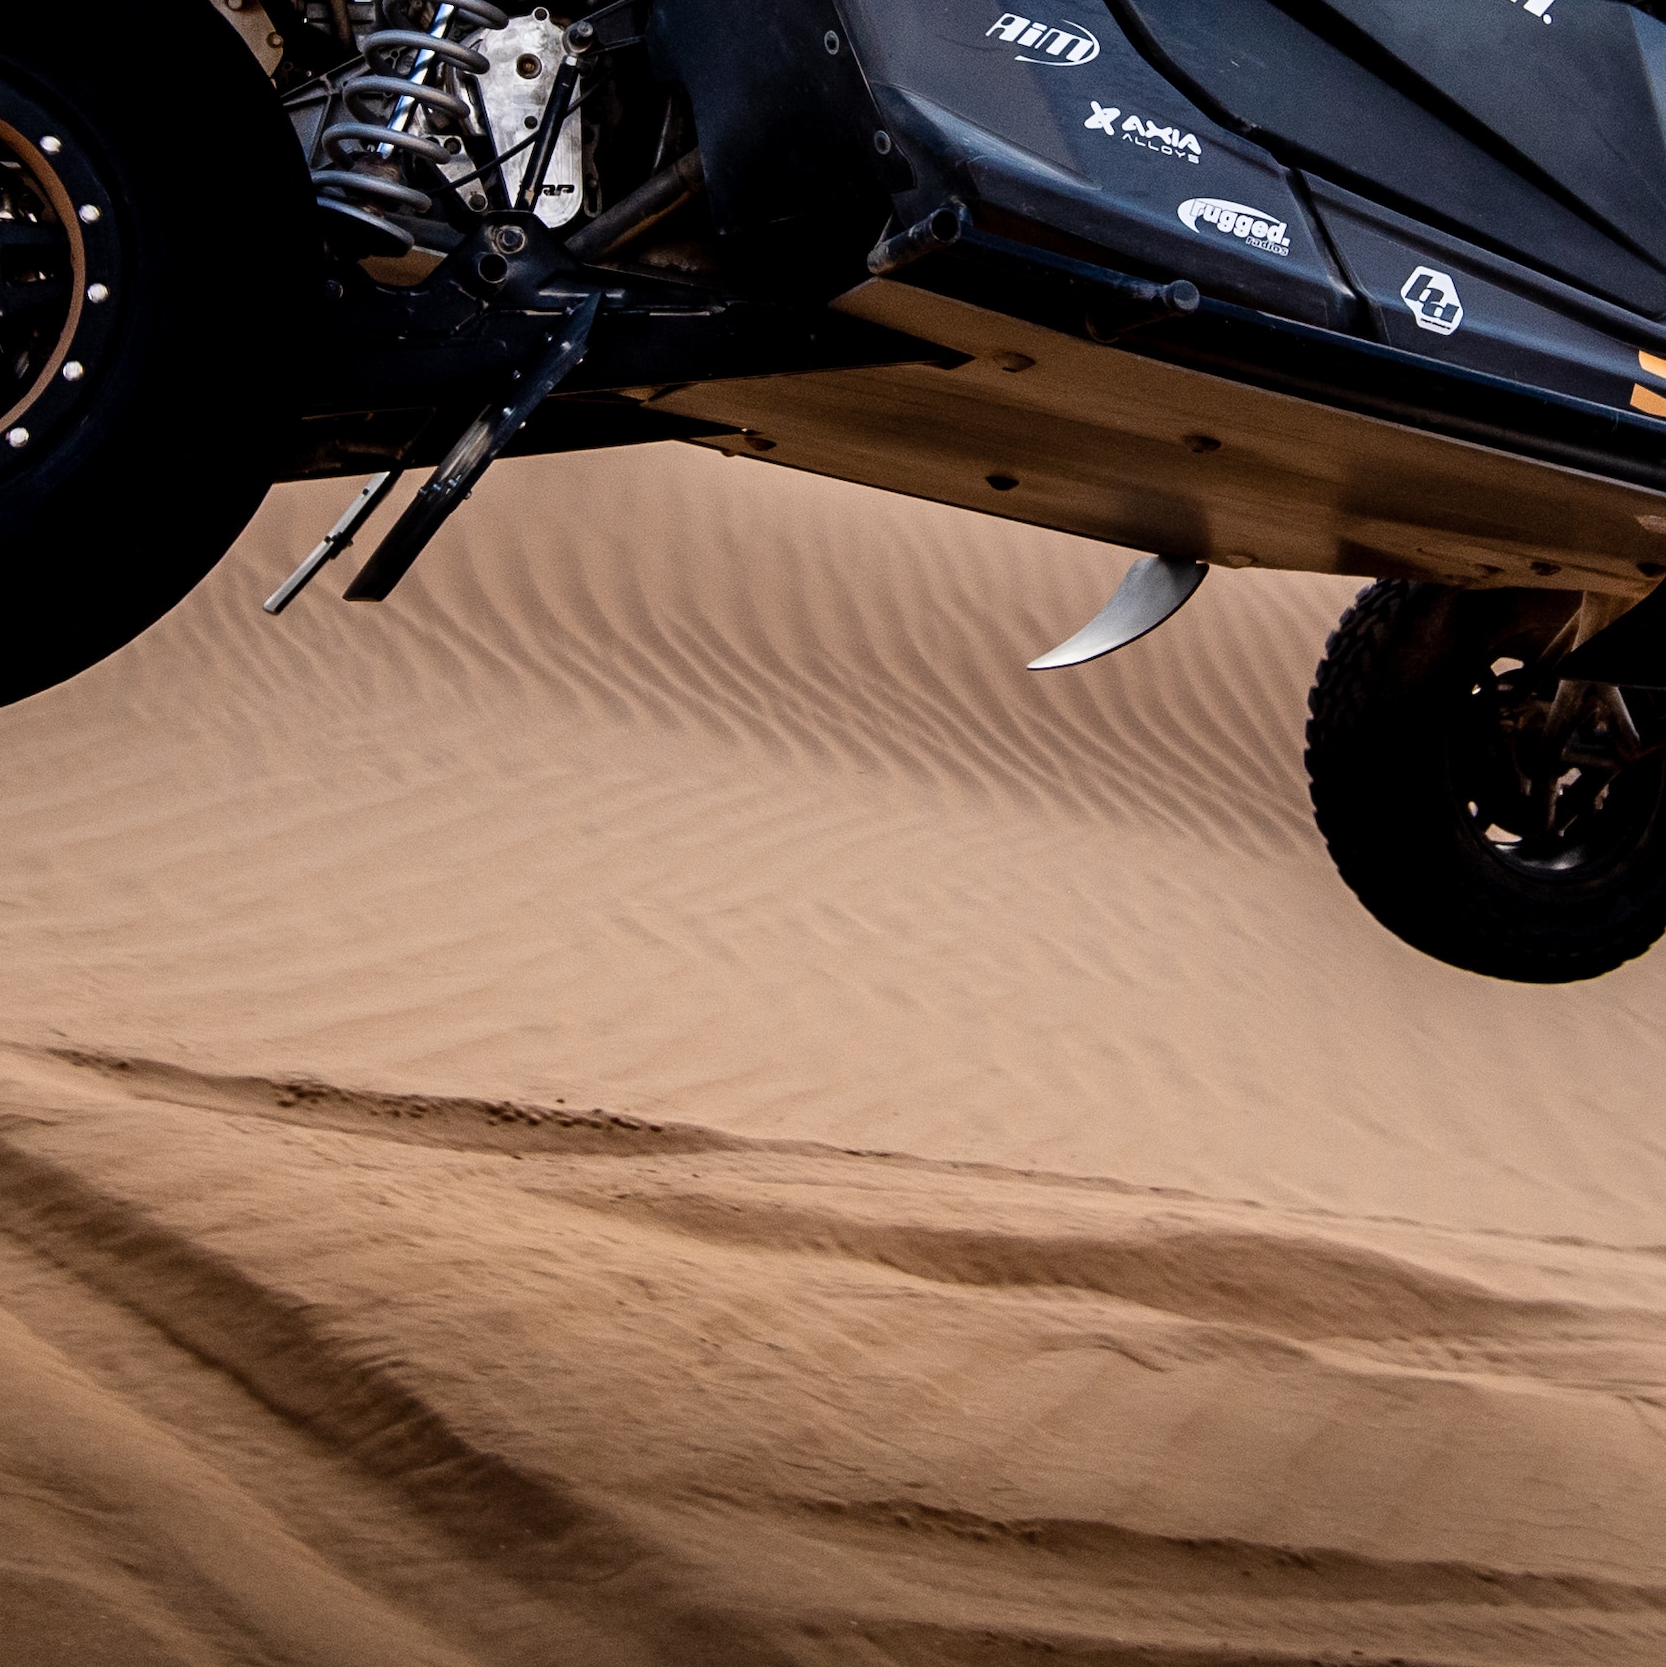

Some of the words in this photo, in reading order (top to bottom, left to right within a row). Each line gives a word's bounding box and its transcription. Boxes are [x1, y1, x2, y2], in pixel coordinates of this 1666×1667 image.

[1121, 115, 1202, 155] AXIA
[1122, 133, 1200, 164] ALLOYS
[1245, 235, 1290, 257] radios
